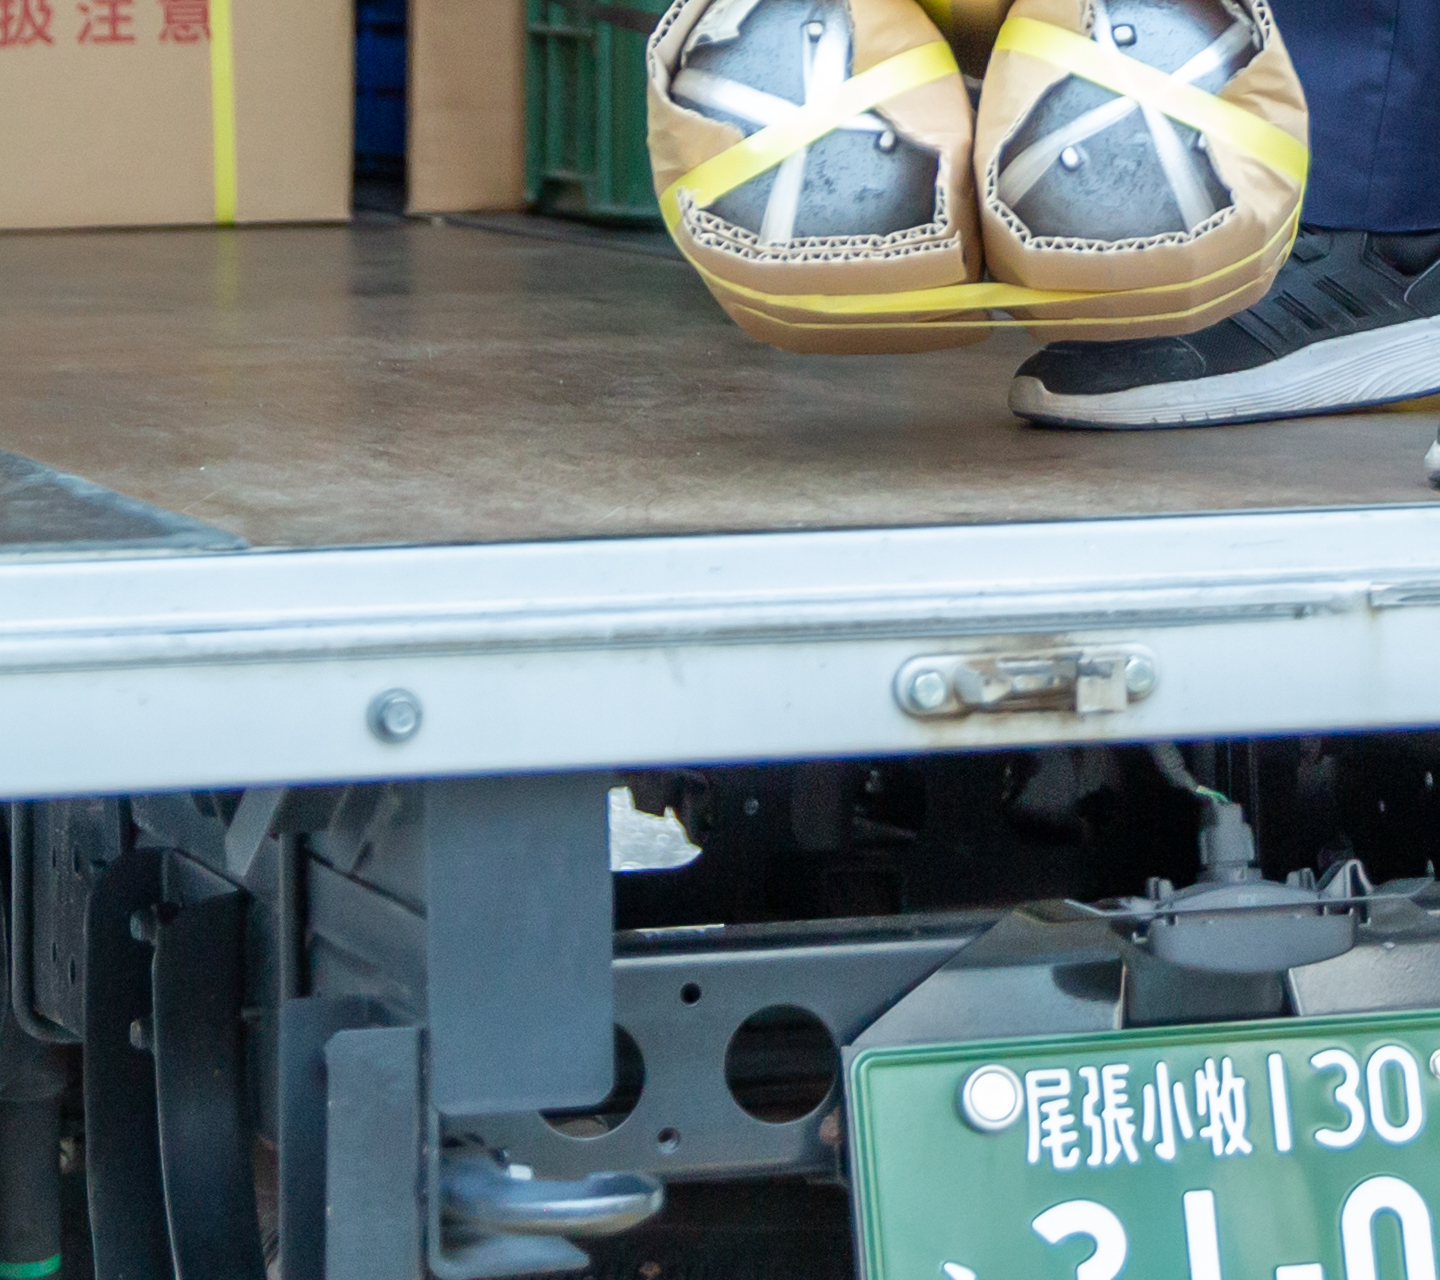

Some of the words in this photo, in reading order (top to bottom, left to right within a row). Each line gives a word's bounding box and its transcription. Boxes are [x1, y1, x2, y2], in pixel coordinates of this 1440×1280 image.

[1024, 1055, 1253, 1169] 尾張小牧
[1266, 1043, 1426, 1153] 130
